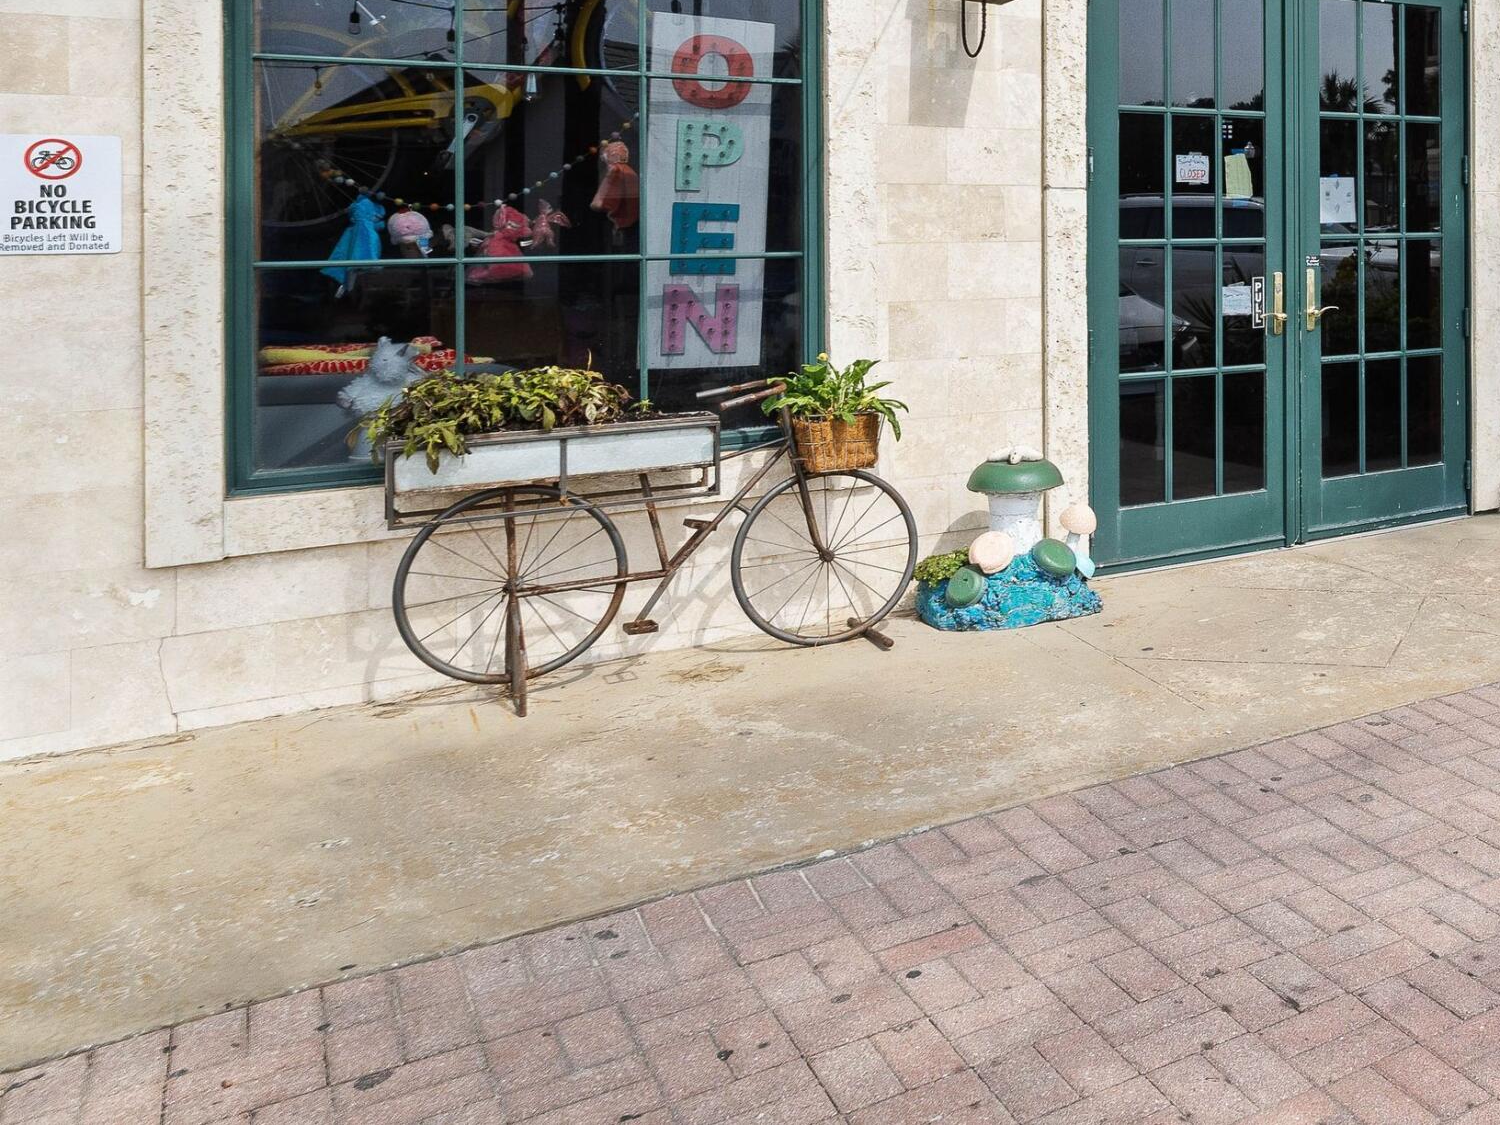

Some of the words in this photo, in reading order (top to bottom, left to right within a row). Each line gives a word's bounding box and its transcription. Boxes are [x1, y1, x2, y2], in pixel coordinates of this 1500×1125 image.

[39, 184, 68, 198] NO
[660, 33, 754, 357] OPEN
[14, 199, 92, 214] BICYCLE
[10, 215, 96, 230] PARKING
[4, 234, 44, 244] Bicycles
[47, 233, 66, 242] Left
[70, 233, 89, 242] Will
[91, 232, 104, 242] be
[0, 242, 44, 252] Removed
[47, 241, 66, 251] and
[69, 241, 110, 250] Donated
[1254, 281, 1262, 324] PULL
